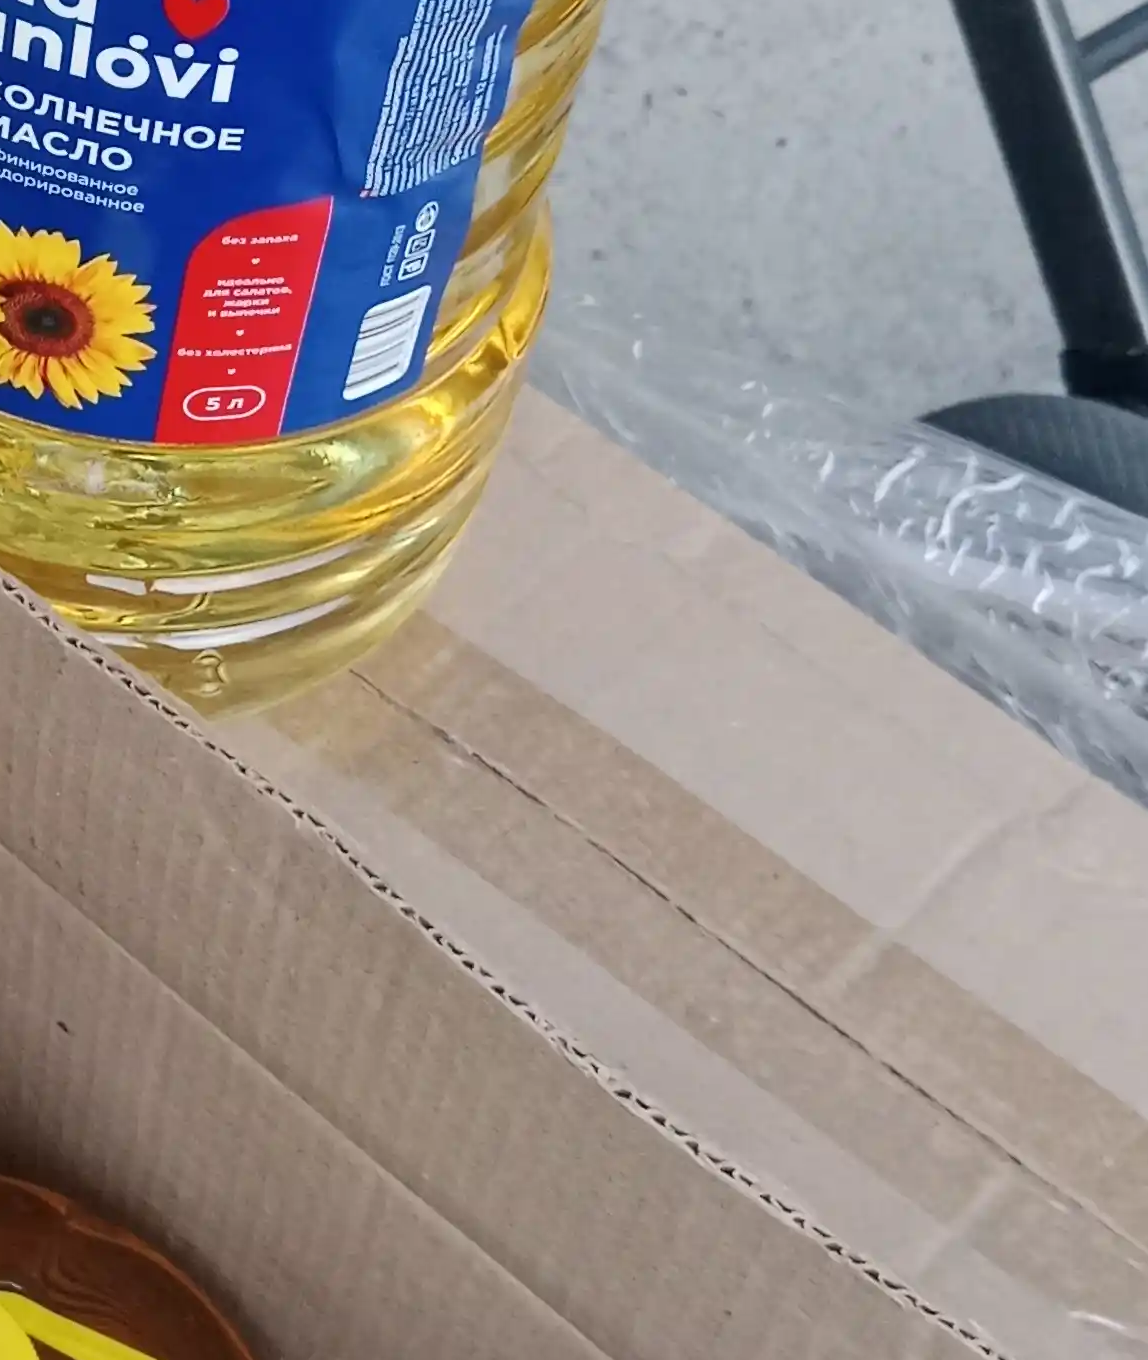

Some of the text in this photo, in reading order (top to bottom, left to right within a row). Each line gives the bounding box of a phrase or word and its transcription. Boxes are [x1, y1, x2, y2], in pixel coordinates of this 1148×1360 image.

[177, 347, 202, 357] без
[205, 396, 245, 411] 5 л
